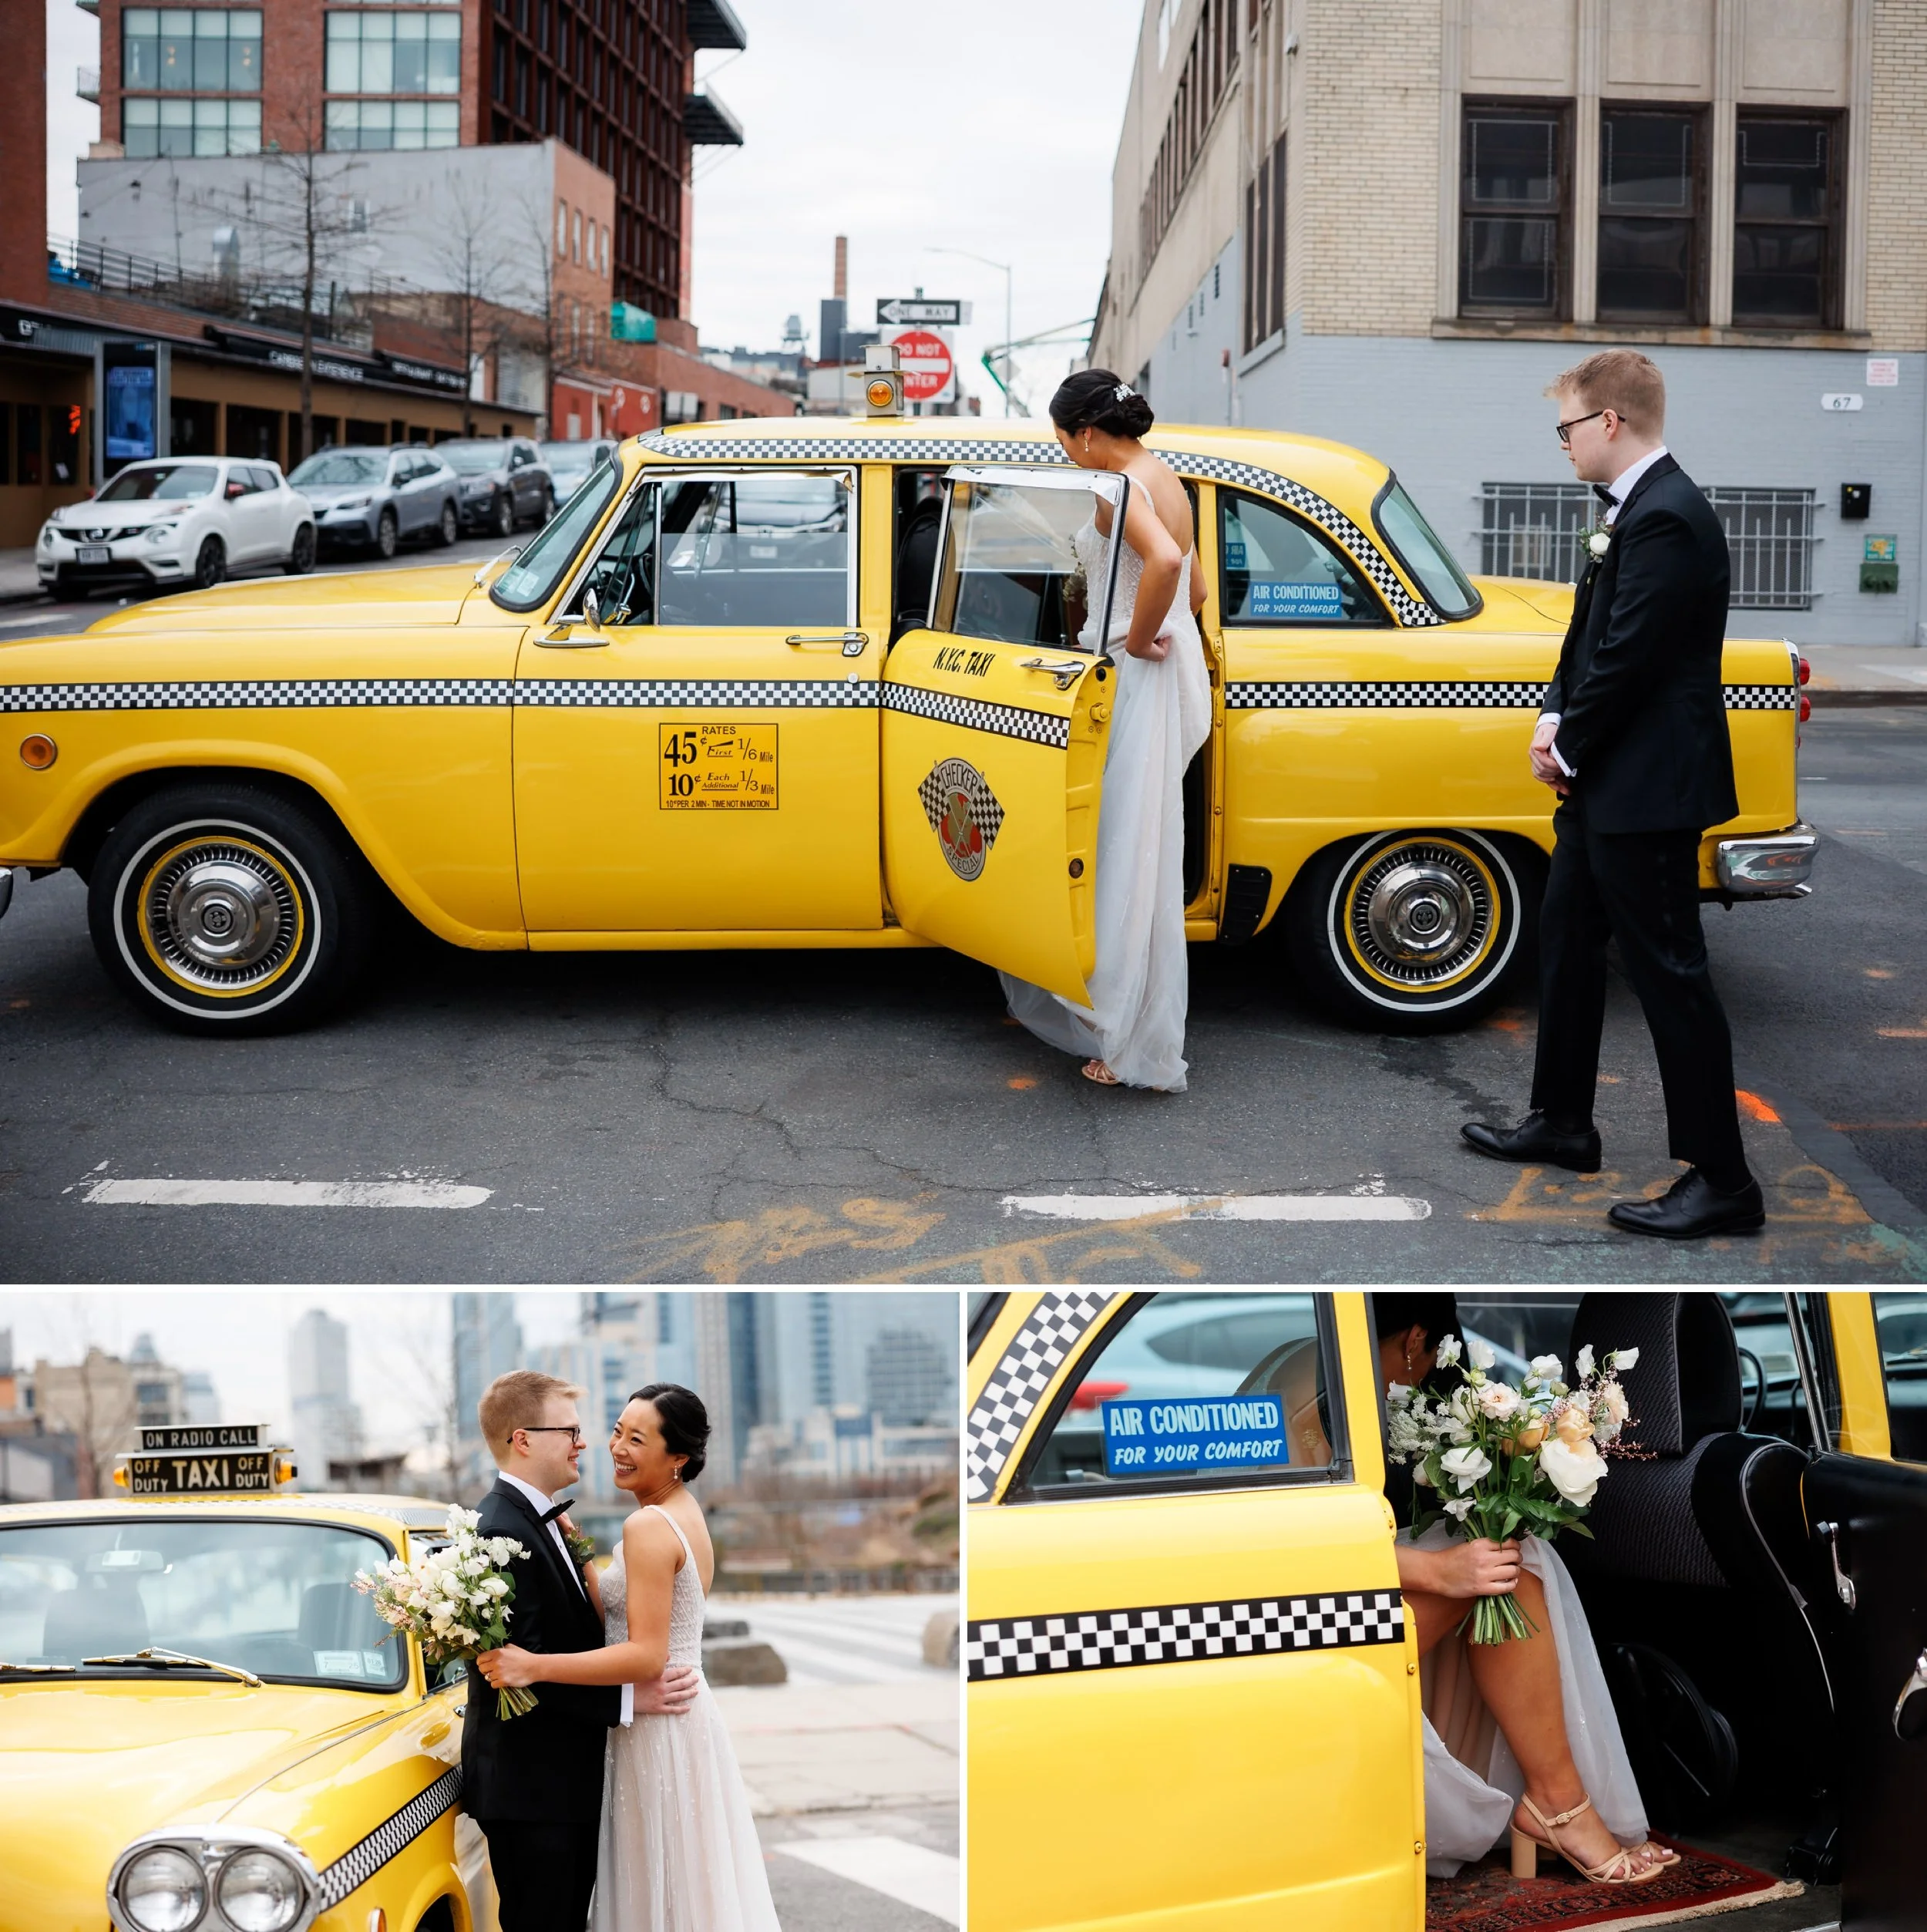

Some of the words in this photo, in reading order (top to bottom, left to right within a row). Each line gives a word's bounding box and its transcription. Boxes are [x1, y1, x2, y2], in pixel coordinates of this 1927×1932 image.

[890, 307, 910, 317] ONE
[926, 308, 949, 317] WAY
[896, 343, 913, 355] DO
[916, 343, 941, 356] NOT
[903, 375, 938, 388] NTER
[1833, 397, 1851, 408] 67
[1253, 585, 1270, 599] AIR
[1273, 585, 1339, 600] CONDITIONED
[1273, 604, 1296, 613] YOUR
[1298, 604, 1340, 614] COMFORT
[964, 651, 996, 677] TAXI
[707, 740, 733, 756] First
[738, 738, 757, 760] 1/6
[759, 751, 773, 762] Mile
[707, 772, 730, 781] Each
[740, 769, 758, 791] 1/3
[761, 784, 775, 795] Mile
[940, 763, 977, 795] CHECKER
[948, 846, 979, 871] SPECIAL
[1110, 1407, 1145, 1437] AIR
[1149, 1402, 1280, 1435] CONDITIONED
[146, 1432, 164, 1448] ON
[171, 1429, 214, 1447] RADIO
[220, 1428, 257, 1445] CALL
[1115, 1446, 1147, 1465] FOR
[1154, 1443, 1200, 1463] YOUR
[1204, 1439, 1283, 1460] COMFORT
[134, 1459, 160, 1474] OFF
[172, 1459, 230, 1489] TAXI
[237, 1456, 264, 1471] OFF
[134, 1478, 168, 1493] DUTY
[235, 1473, 269, 1488] DUTY
